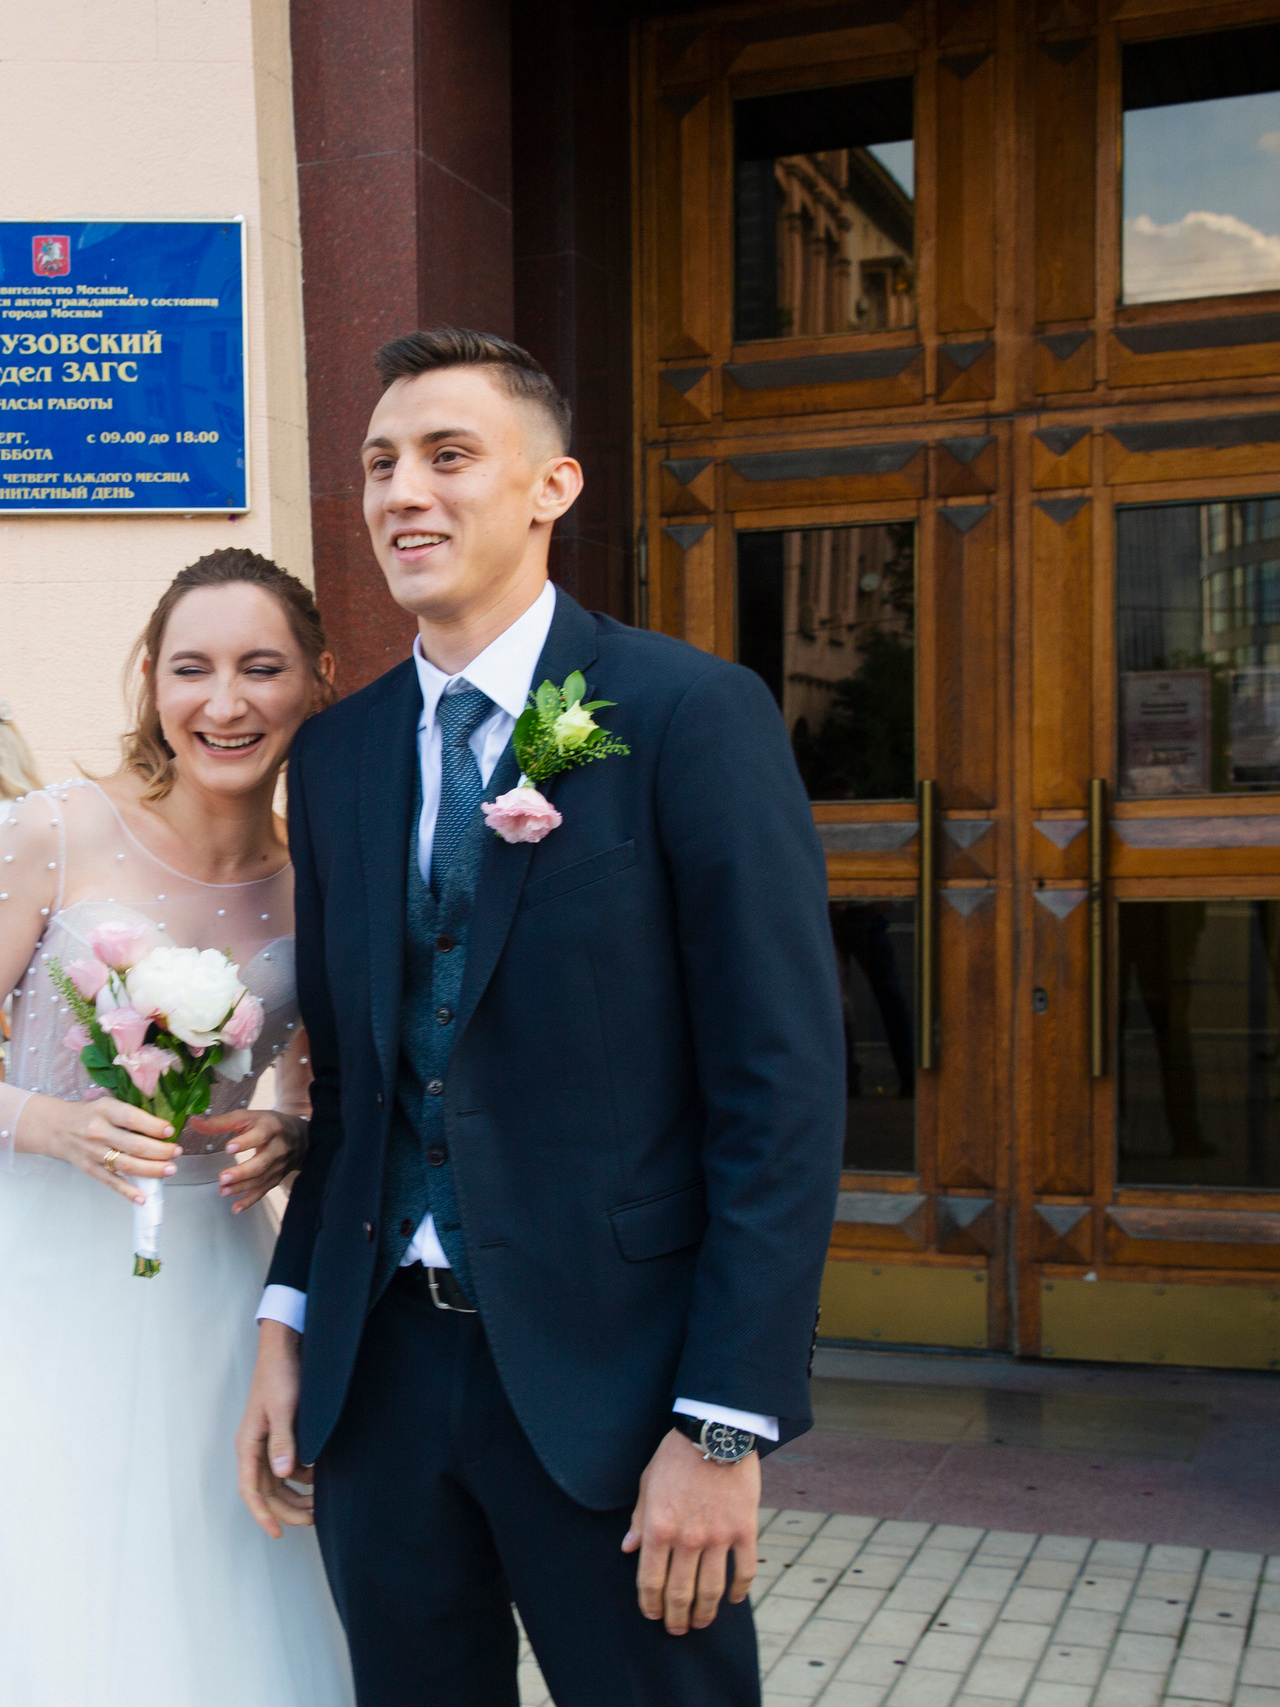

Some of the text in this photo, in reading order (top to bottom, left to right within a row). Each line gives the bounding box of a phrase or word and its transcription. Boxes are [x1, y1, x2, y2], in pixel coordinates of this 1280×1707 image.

[76, 285, 128, 294] Москвы
[14, 298, 52, 306] актов
[56, 298, 148, 308] гражданского
[151, 298, 218, 306] состояния
[2, 308, 103, 320] города Москвы
[62, 362, 138, 382] ЗАГС
[47, 398, 113, 410] РАБОТЫ
[86, 434, 96, 443] с
[100, 431, 146, 443] 09.00
[148, 434, 170, 445] до
[3, 473, 60, 483] ЧЕТВЕРГ
[63, 473, 132, 483] КАЖДОГО
[135, 472, 190, 483] МЕСЯЦА
[91, 487, 135, 500] ДЕНЬ
